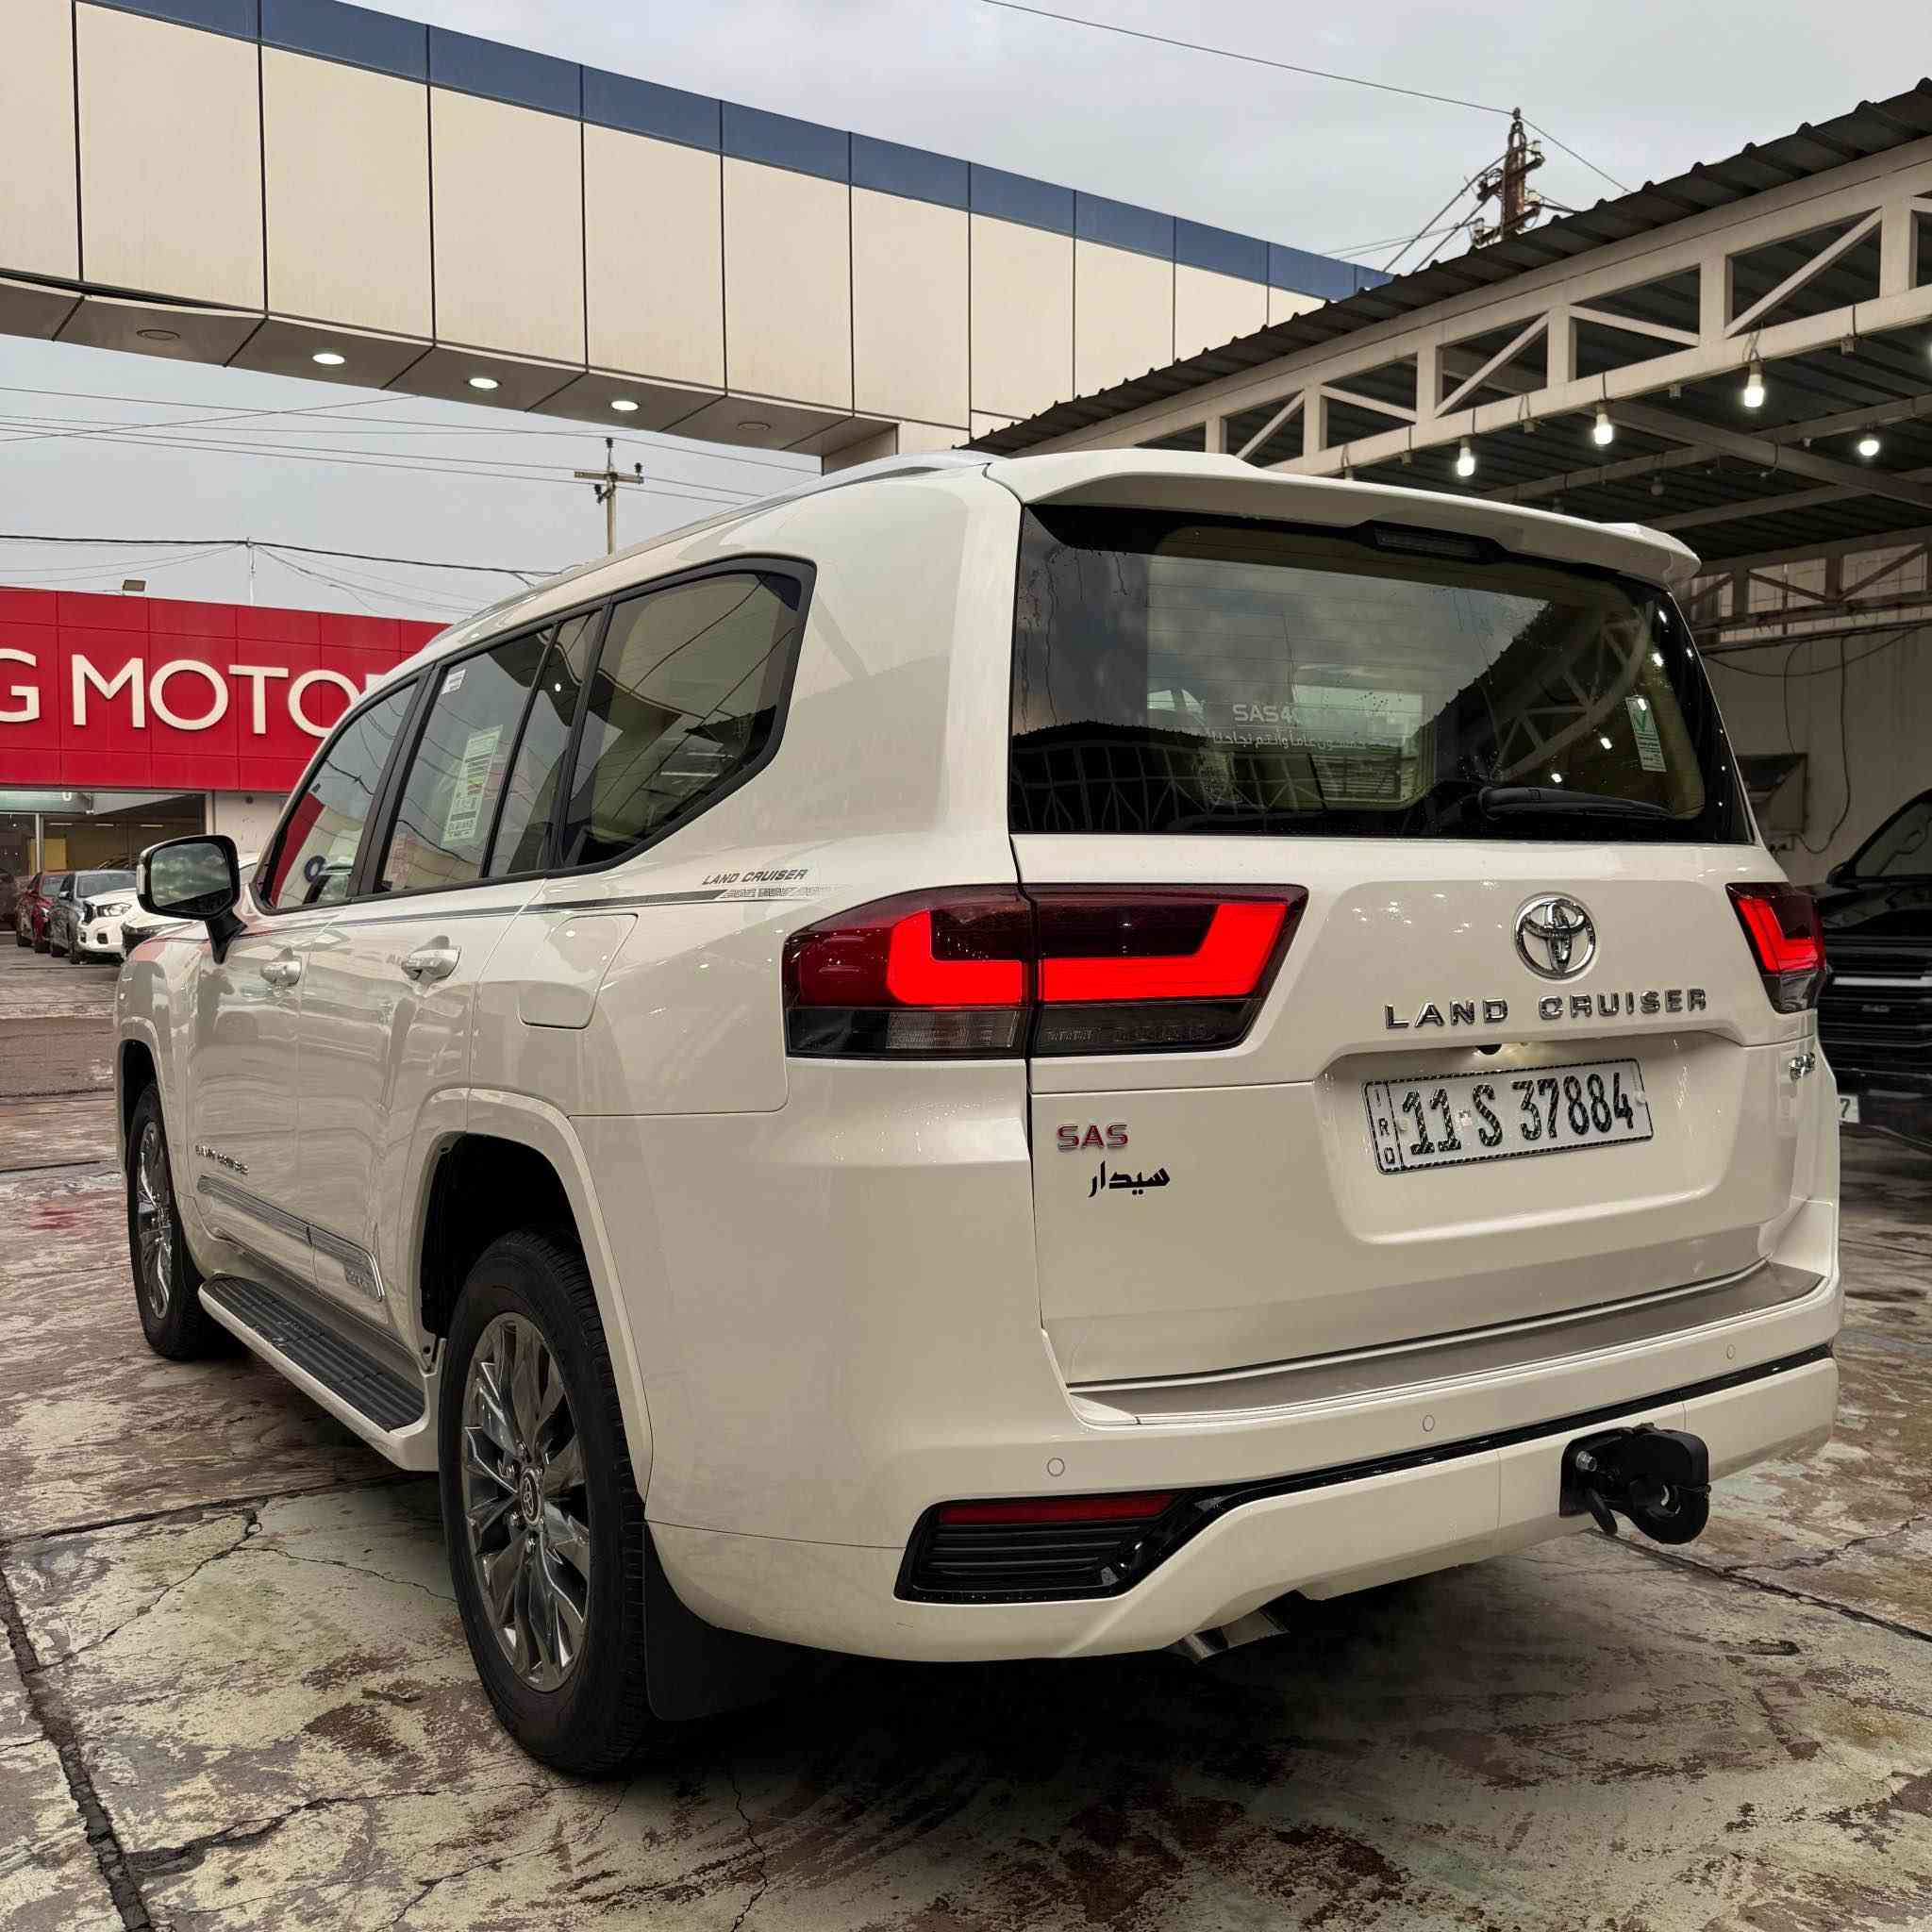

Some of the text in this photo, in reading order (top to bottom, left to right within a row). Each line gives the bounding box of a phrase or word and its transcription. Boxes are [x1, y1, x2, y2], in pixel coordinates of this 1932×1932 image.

[72, 654, 388, 739] MOTO
[702, 869, 808, 886] LAND CRUISER
[1384, 988, 1707, 1029] LAND CRUISER
[1402, 1072, 1634, 1156] 11 S 37884
[1057, 1123, 1129, 1150] SAS
[1088, 1160, 1171, 1198] سيدار
